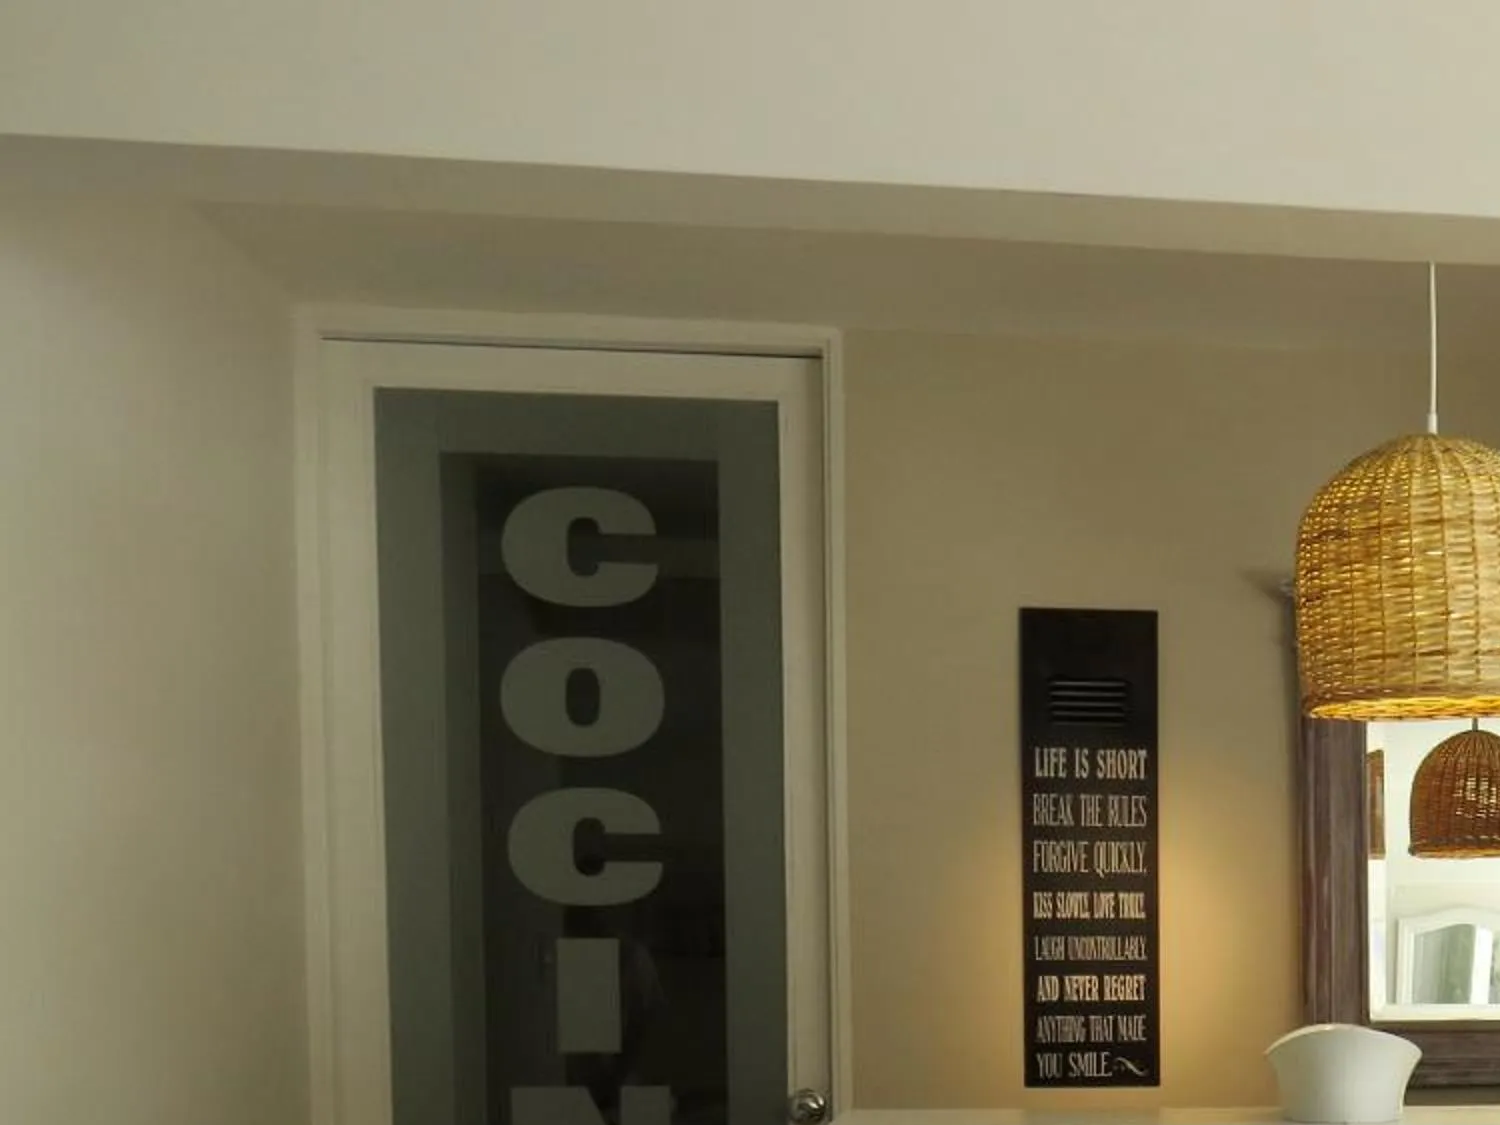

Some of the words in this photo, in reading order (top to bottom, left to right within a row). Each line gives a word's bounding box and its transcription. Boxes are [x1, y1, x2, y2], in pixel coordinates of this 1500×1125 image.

[1034, 747, 1067, 778] LIFE
[1074, 748, 1090, 779] IS
[1096, 748, 1148, 780] SHORT
[1033, 793, 1075, 826] BREAK
[1080, 794, 1104, 827] THE
[1108, 794, 1148, 827] RULES
[1033, 840, 1089, 873] FORGIVE
[1037, 975, 1060, 1002] AND
[1063, 975, 1100, 1002] NEVER
[1103, 974, 1146, 1001] REGRET
[1036, 1015, 1087, 1043] ANYTHING
[1089, 1015, 1114, 1042] THAT
[1117, 1015, 1148, 1041] MADE
[1036, 1052, 1063, 1078] YOU
